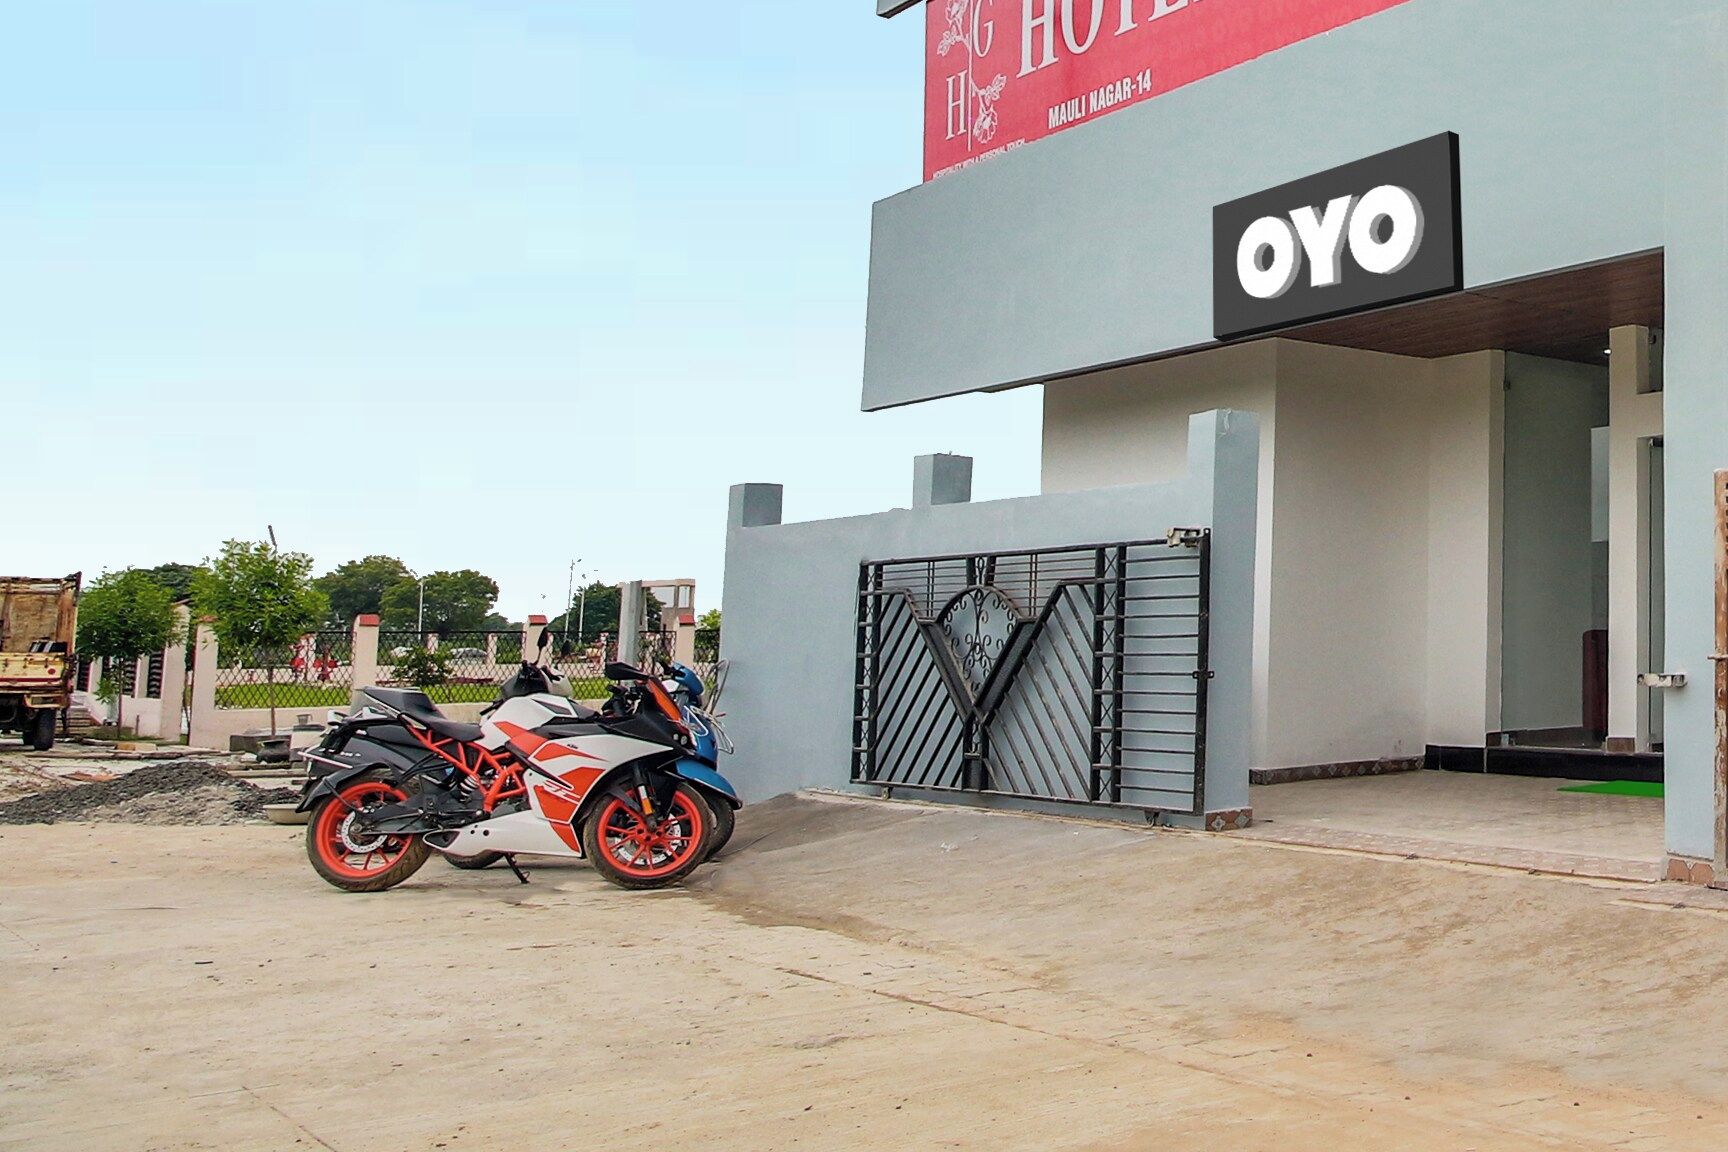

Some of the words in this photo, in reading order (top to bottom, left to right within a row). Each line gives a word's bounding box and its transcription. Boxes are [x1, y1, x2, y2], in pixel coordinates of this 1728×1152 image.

[945, 69, 968, 141] H
[1047, 94, 1087, 129] MAULI
[1088, 68, 1152, 114] NAGAR-14
[1236, 184, 1425, 299] OYO
